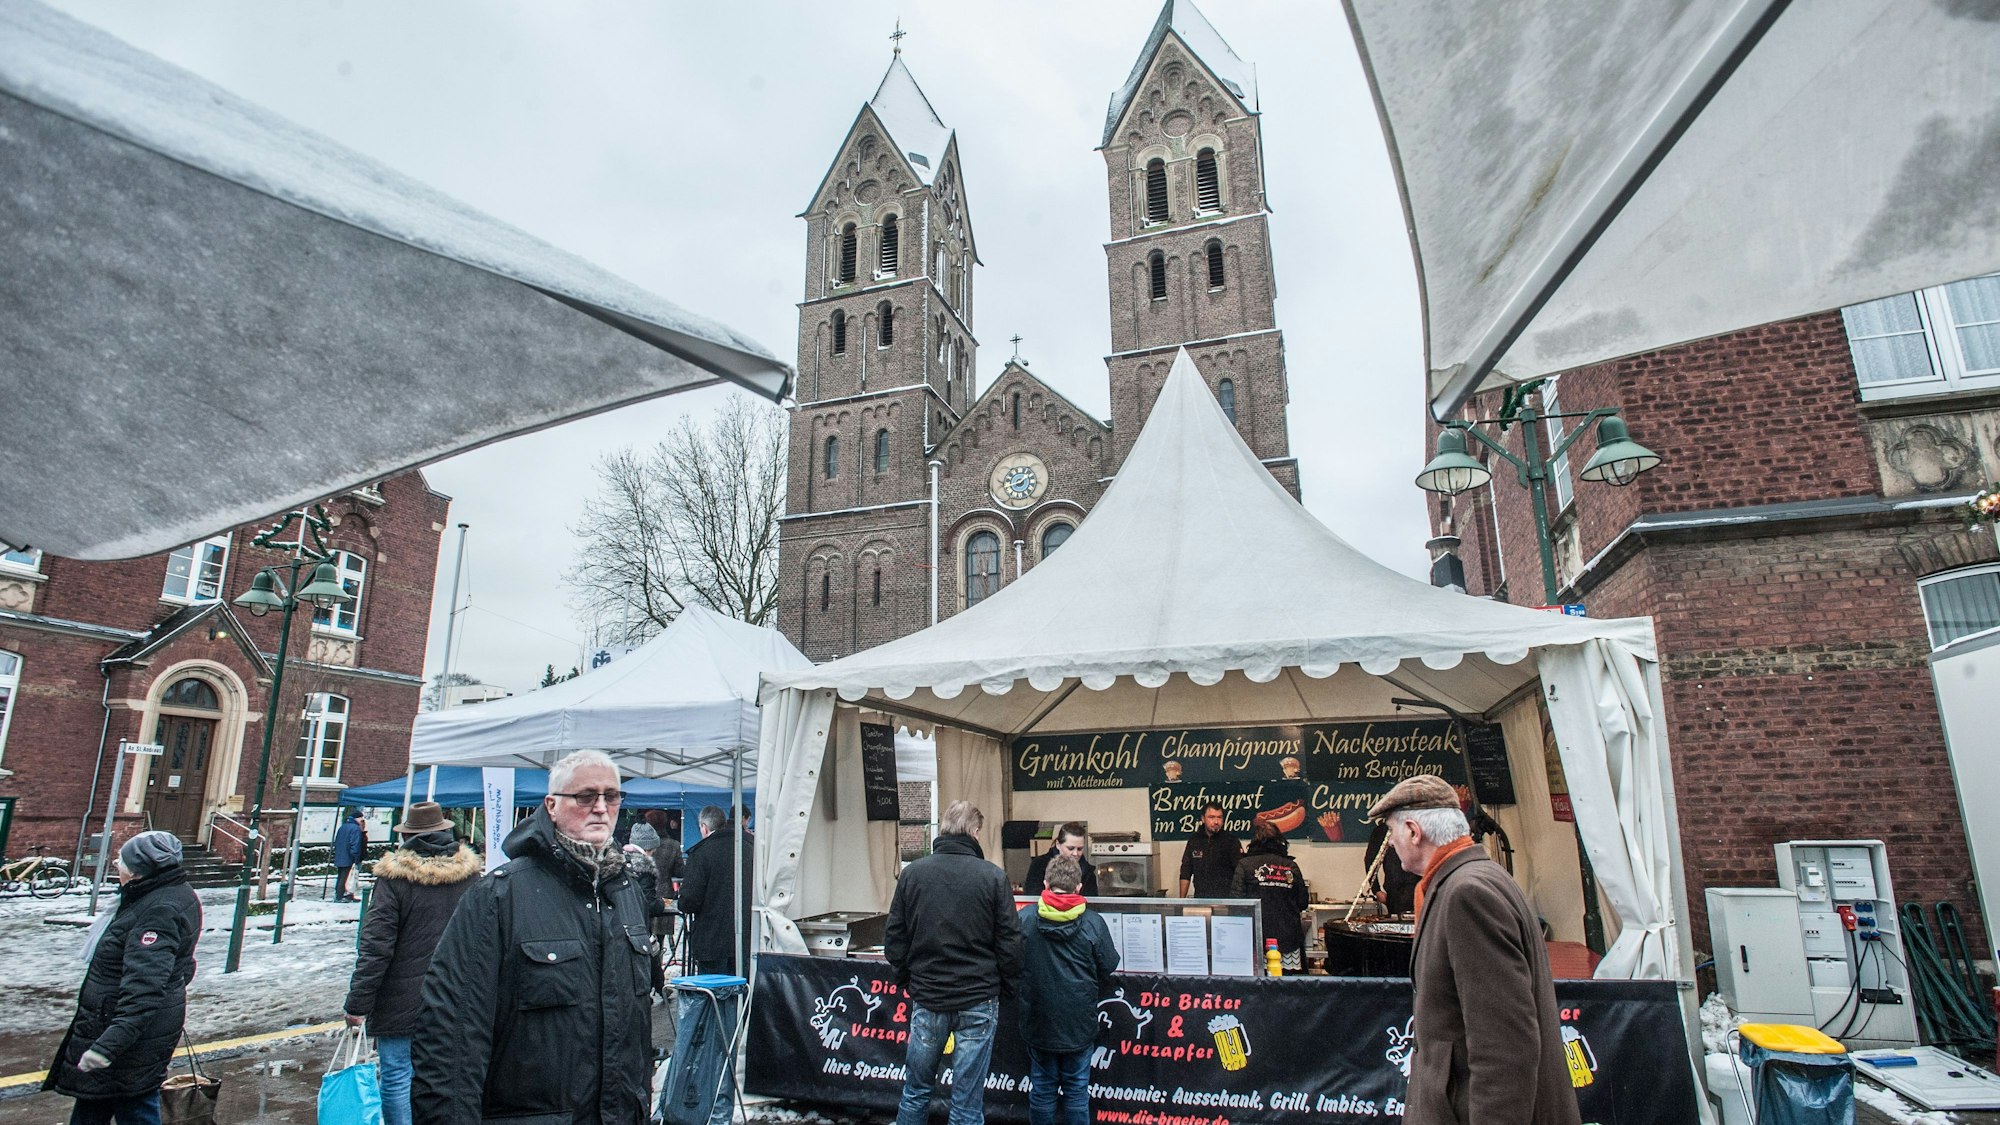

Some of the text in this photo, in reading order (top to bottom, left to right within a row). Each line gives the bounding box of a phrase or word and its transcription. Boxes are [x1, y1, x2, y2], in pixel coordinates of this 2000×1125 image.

[1312, 722, 1461, 756] Nackensteak
[1019, 732, 1148, 777] Grünkohl
[1161, 731, 1300, 770] Champignons
[1046, 772, 1123, 789] mit Mettenden
[1337, 762, 1360, 778] im
[1311, 784, 1386, 824] Curry
[1154, 810, 1251, 832] im Brhen
[871, 980, 897, 994] Die
[892, 1002, 907, 1022] &
[1140, 991, 1242, 1011] Die Bräter
[851, 1023, 911, 1044] Verzap
[1167, 1015, 1184, 1038] &
[1120, 1039, 1214, 1062] Verzapfer
[822, 1058, 851, 1075] Ihre
[853, 1060, 907, 1081] Spezial
[1172, 1086, 1264, 1111] Ausschank,
[1269, 1091, 1311, 1113] Grill,
[1316, 1093, 1379, 1117] Imbiss,
[1384, 1097, 1407, 1116] En
[1096, 1109, 1230, 1125] www.die-braeter.de
